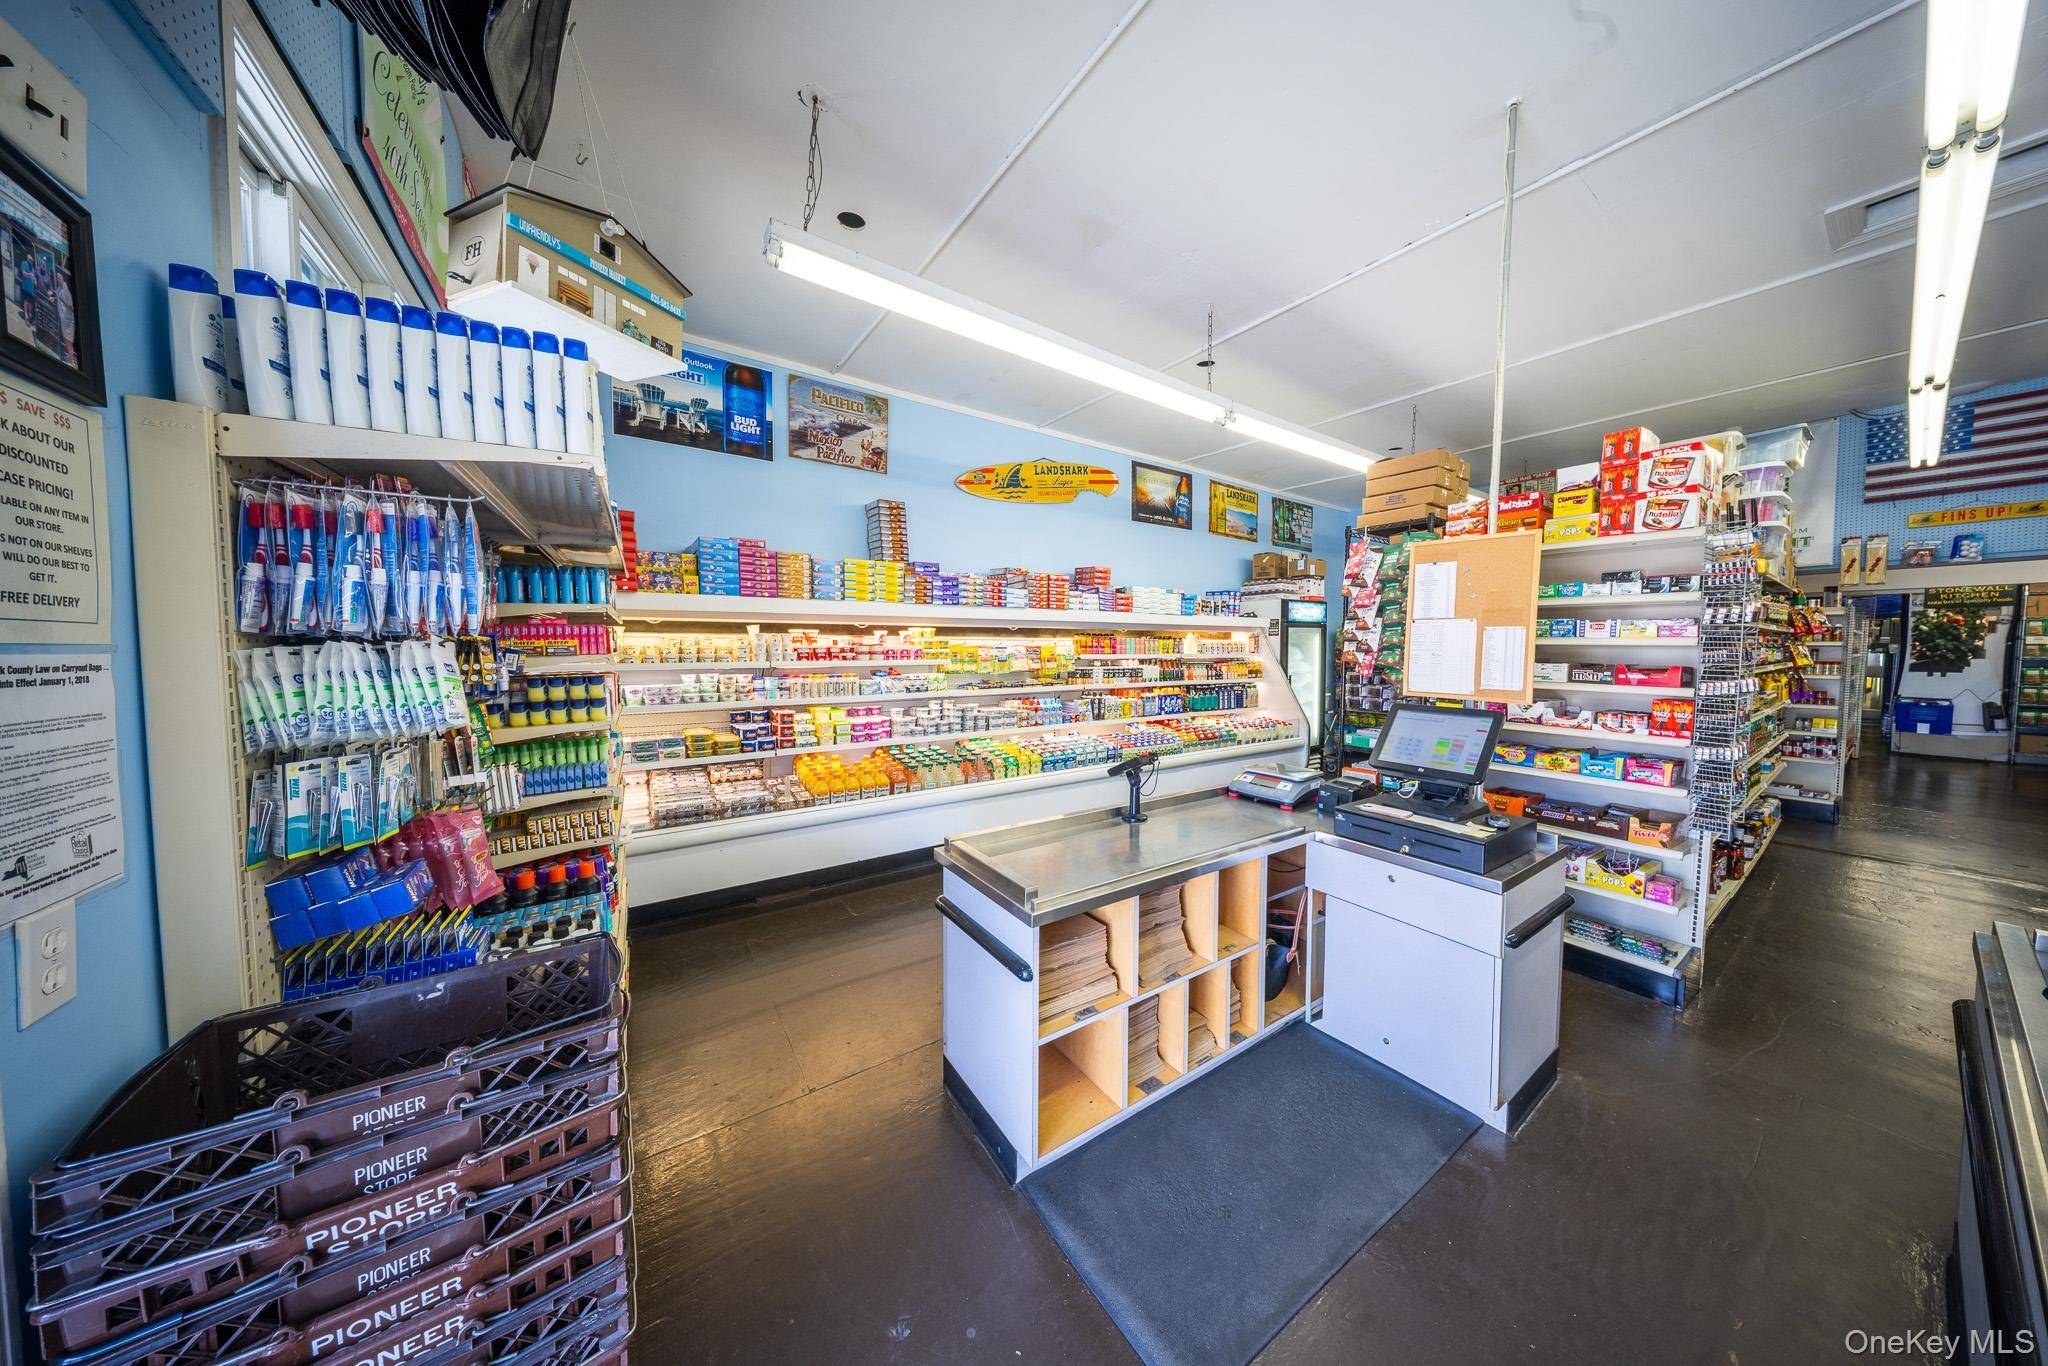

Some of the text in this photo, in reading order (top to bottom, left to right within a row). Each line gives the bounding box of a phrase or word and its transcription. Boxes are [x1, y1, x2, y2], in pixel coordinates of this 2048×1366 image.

[518, 217, 561, 250] UNFRIENDLY'S
[464, 235, 482, 262] FH
[683, 357, 716, 371] Outlook.
[669, 371, 704, 384] IGHT
[16, 397, 46, 419] SAVE
[53, 412, 71, 430] $$$
[734, 414, 757, 427] BUD
[731, 422, 761, 435] LIGHT
[12, 424, 50, 445] ABOUT
[53, 437, 75, 454] OUR
[808, 428, 843, 448] Mexico
[0, 442, 69, 475] DISCOUNTED
[816, 447, 856, 465] Pacifico
[1665, 445, 1692, 456] PACK
[1034, 465, 1089, 476] LANDSHARK
[1654, 468, 1685, 477] nutella
[0, 470, 74, 500] CASE PRICING!
[1660, 487, 1686, 496] PACK
[1226, 489, 1256, 505] LANDSHARK
[0, 494, 89, 524] LABLE ON ANY ITEM IN
[1648, 508, 1679, 518] nutella
[1941, 506, 2013, 522] FINS UP!
[15, 515, 64, 534] OUR STORE.
[1559, 526, 1582, 537] POPS
[7, 535, 27, 548] NOT
[29, 539, 43, 550] ON
[44, 541, 62, 554] OUR
[63, 544, 93, 558] SHELVES
[3, 552, 90, 573] WILL DO OUR BEST TO
[29, 572, 57, 584] GET IT.
[1928, 584, 2014, 595] STONEWALL
[1940, 591, 2000, 600] KITCHEN
[0, 590, 80, 609] FREE DELIVERY
[7, 665, 34, 677] County
[35, 665, 50, 675] Law
[52, 666, 60, 674] on
[61, 664, 87, 675] Carryout
[88, 664, 102, 674] Bags
[16, 677, 37, 688] Effect
[38, 677, 66, 688] January
[67, 676, 74, 686] 1,
[75, 675, 90, 685] 2018
[289, 777, 300, 800] TRIM
[1632, 828, 1658, 839] Twix
[1602, 876, 1626, 888] POPS
[352, 1095, 426, 1131] PIONEER
[354, 1146, 428, 1186] PIONEER
[305, 1181, 458, 1250] PIONEER
[357, 1247, 431, 1291] PIONEER
[311, 1276, 463, 1356] PIONEER
